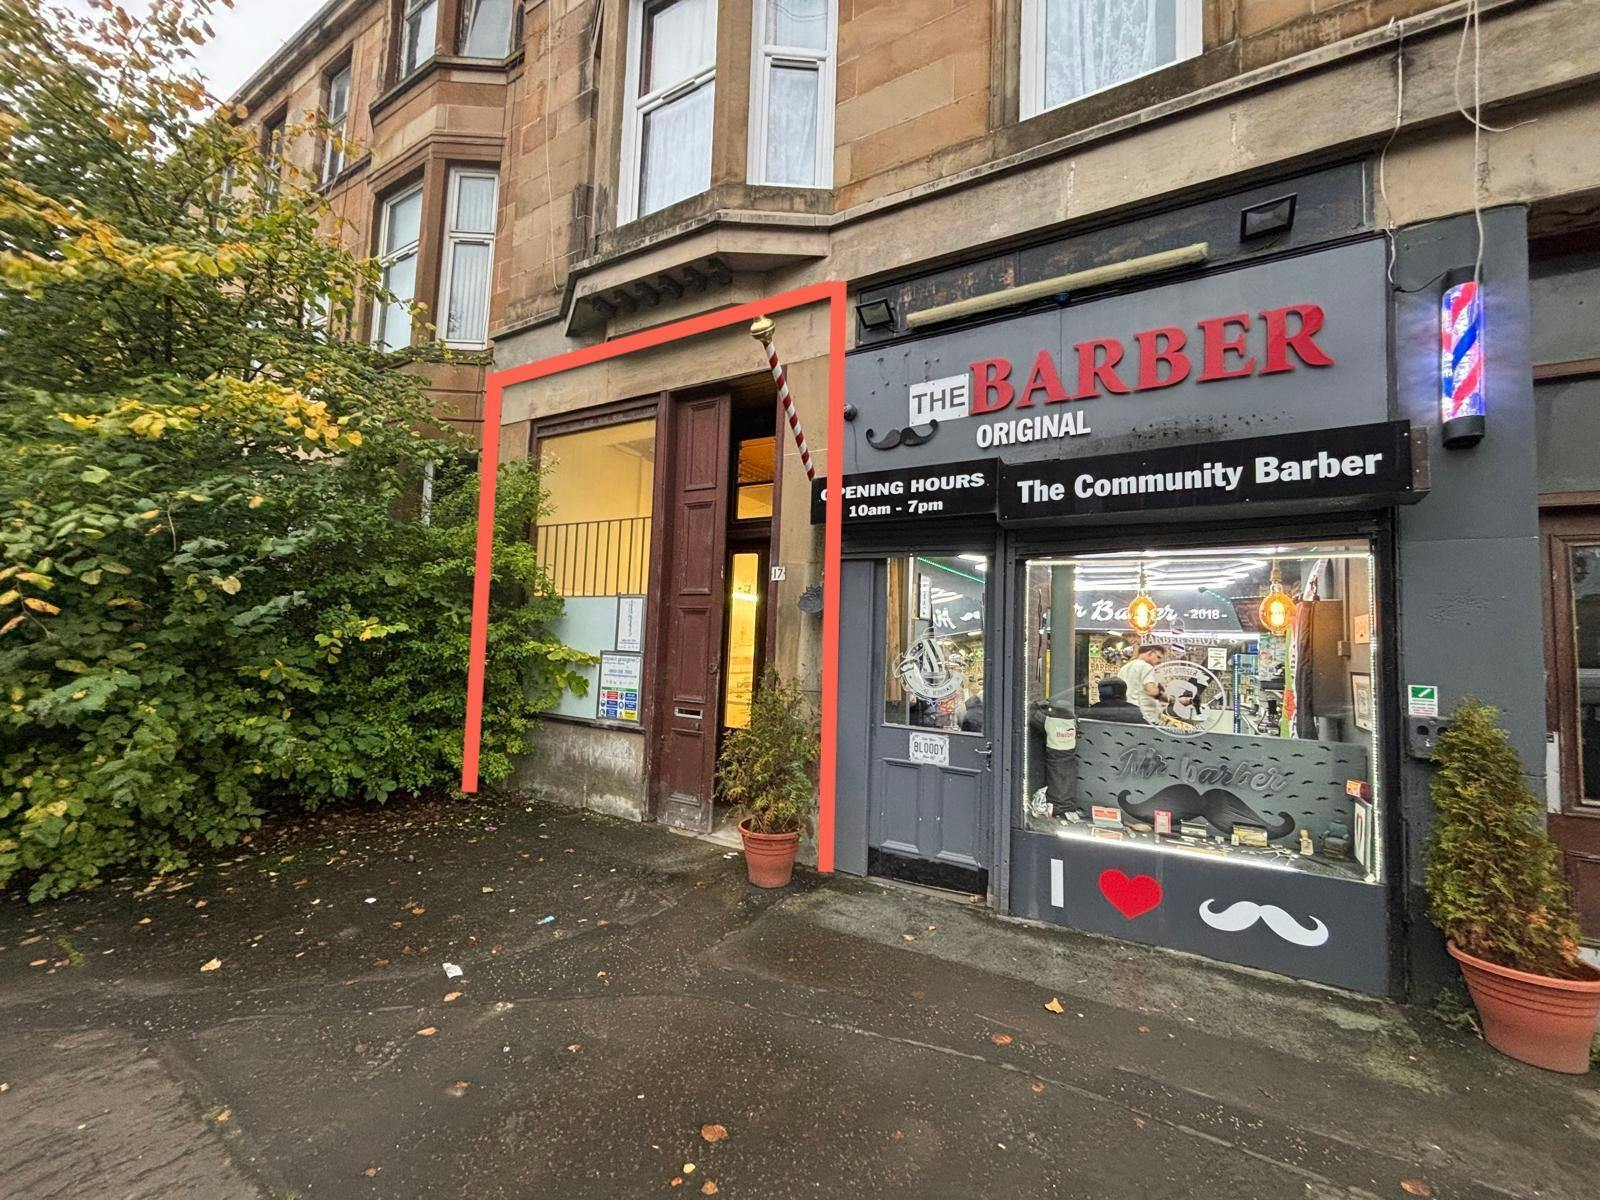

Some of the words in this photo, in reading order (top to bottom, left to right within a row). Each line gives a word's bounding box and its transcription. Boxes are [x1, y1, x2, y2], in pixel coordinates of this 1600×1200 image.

[912, 385, 966, 414] THE
[969, 303, 1335, 415] BARBER
[976, 410, 1092, 449] ORIGINAL
[910, 472, 986, 494] HOURS
[1016, 479, 1065, 504] The
[1074, 462, 1244, 499] Community
[1255, 451, 1383, 484] Barber
[849, 504, 891, 518] 10am
[907, 500, 944, 514] 7pm
[773, 568, 784, 580] 17
[1091, 599, 1178, 622] Baer
[1050, 858, 1064, 908] I
